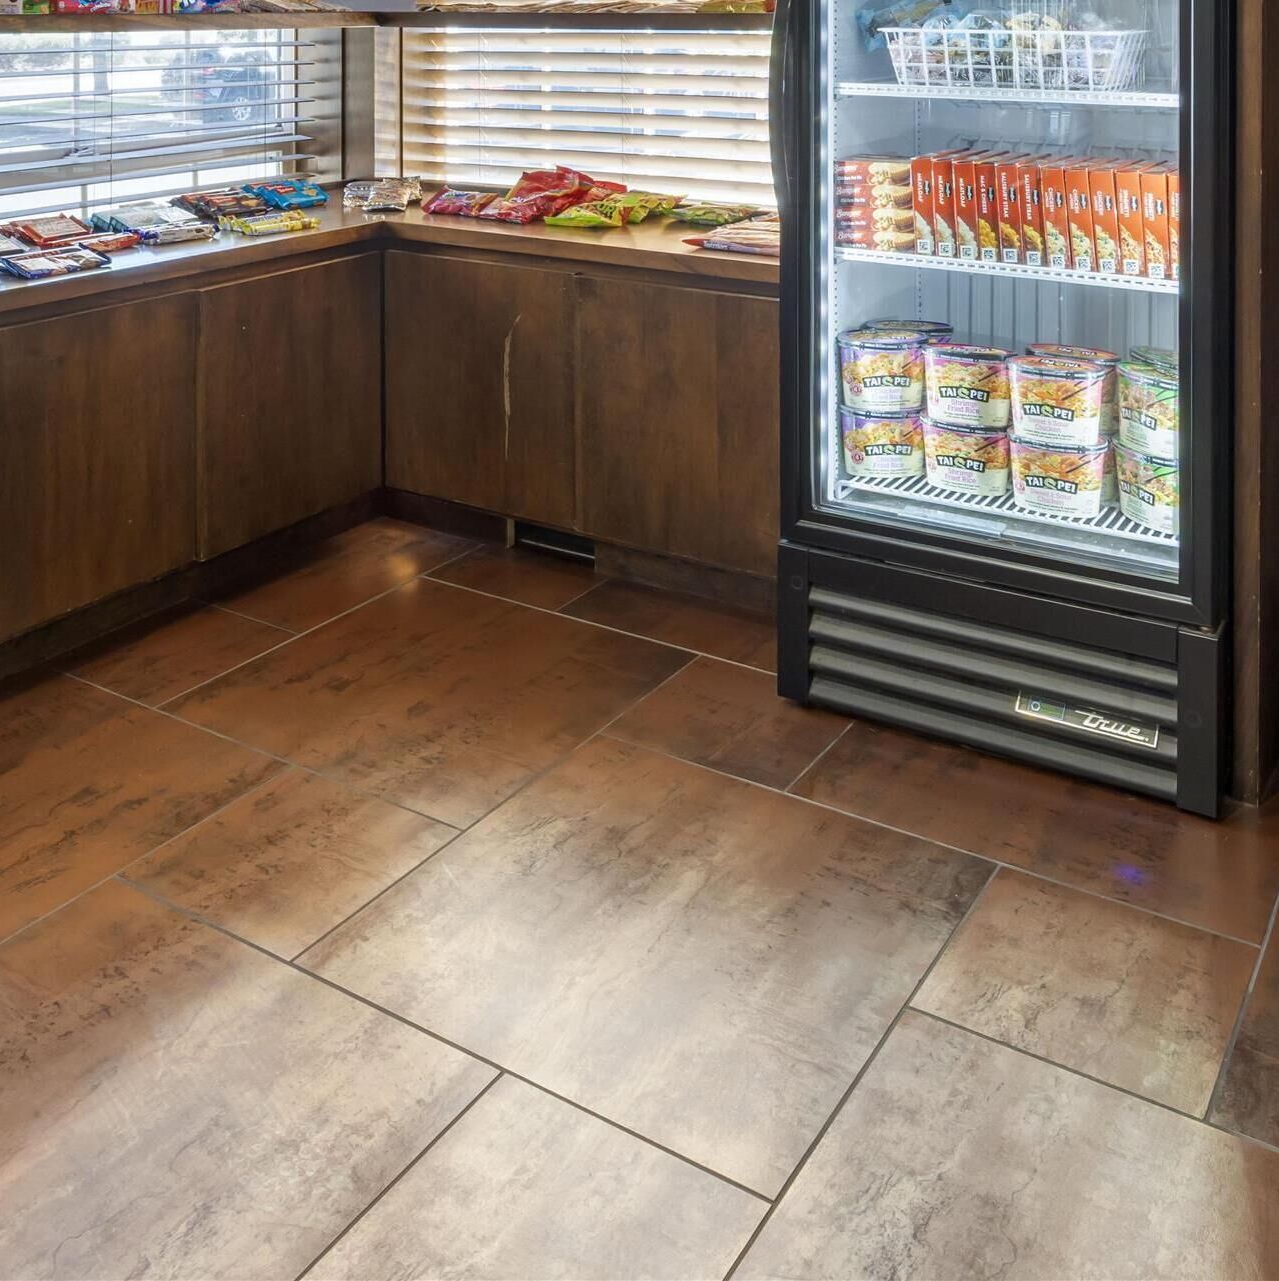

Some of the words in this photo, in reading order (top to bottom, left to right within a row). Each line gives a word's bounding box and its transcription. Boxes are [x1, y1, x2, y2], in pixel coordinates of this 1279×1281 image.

[864, 377, 881, 387] TAI
[894, 376, 910, 386] PEI
[940, 387, 957, 397] TAI
[970, 390, 988, 402] PEI
[1024, 405, 1040, 415] TAI
[1054, 408, 1072, 420] PEI
[1140, 415, 1156, 429] PEI
[866, 446, 883, 455] TAI
[896, 445, 911, 455] PEI
[937, 456, 953, 466] TAI
[966, 459, 984, 471] PEI
[1027, 477, 1043, 487] TAI
[1058, 480, 1076, 492] PEI
[1139, 490, 1155, 505] PEI
